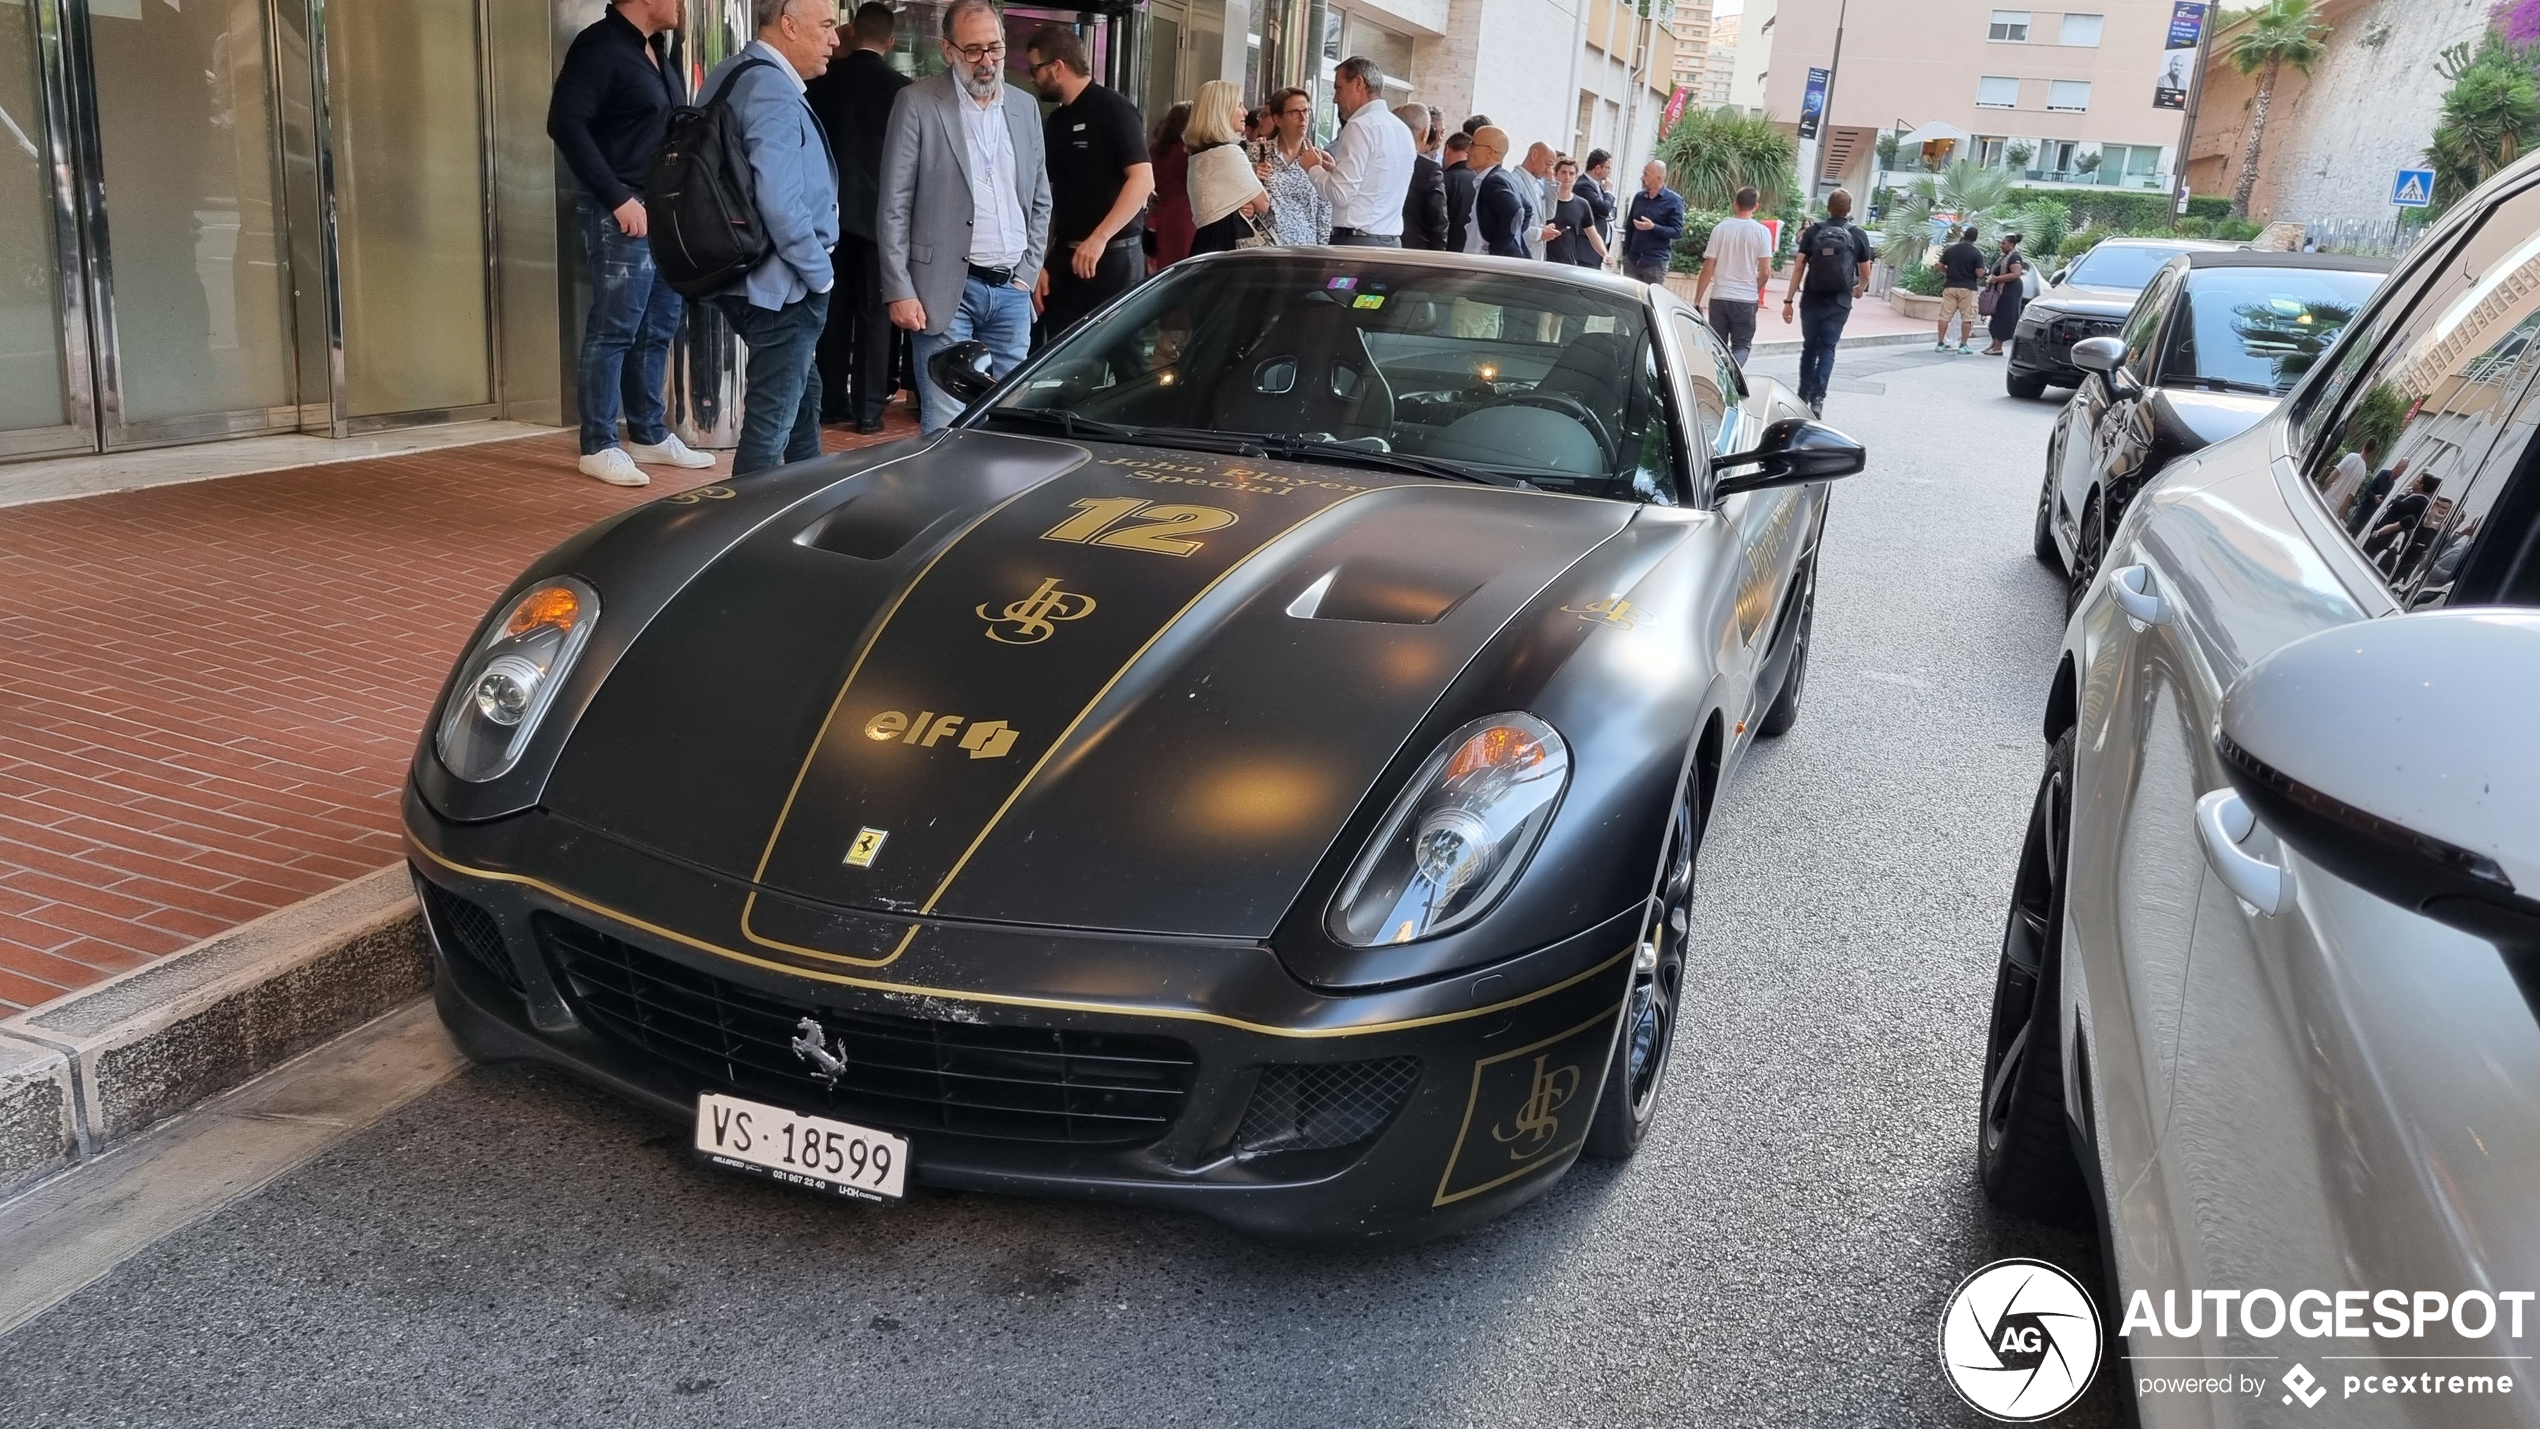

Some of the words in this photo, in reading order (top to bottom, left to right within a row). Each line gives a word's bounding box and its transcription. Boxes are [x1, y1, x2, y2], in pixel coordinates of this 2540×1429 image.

[1098, 457, 1205, 474] John
[1218, 467, 1367, 493] Player
[1124, 470, 1294, 496] Special
[1039, 497, 1239, 557] 12
[865, 710, 965, 747] elf
[773, 1170, 787, 1180] 021
[788, 1174, 803, 1183] 967
[804, 1177, 815, 1187] 22
[815, 1180, 826, 1190] 40
